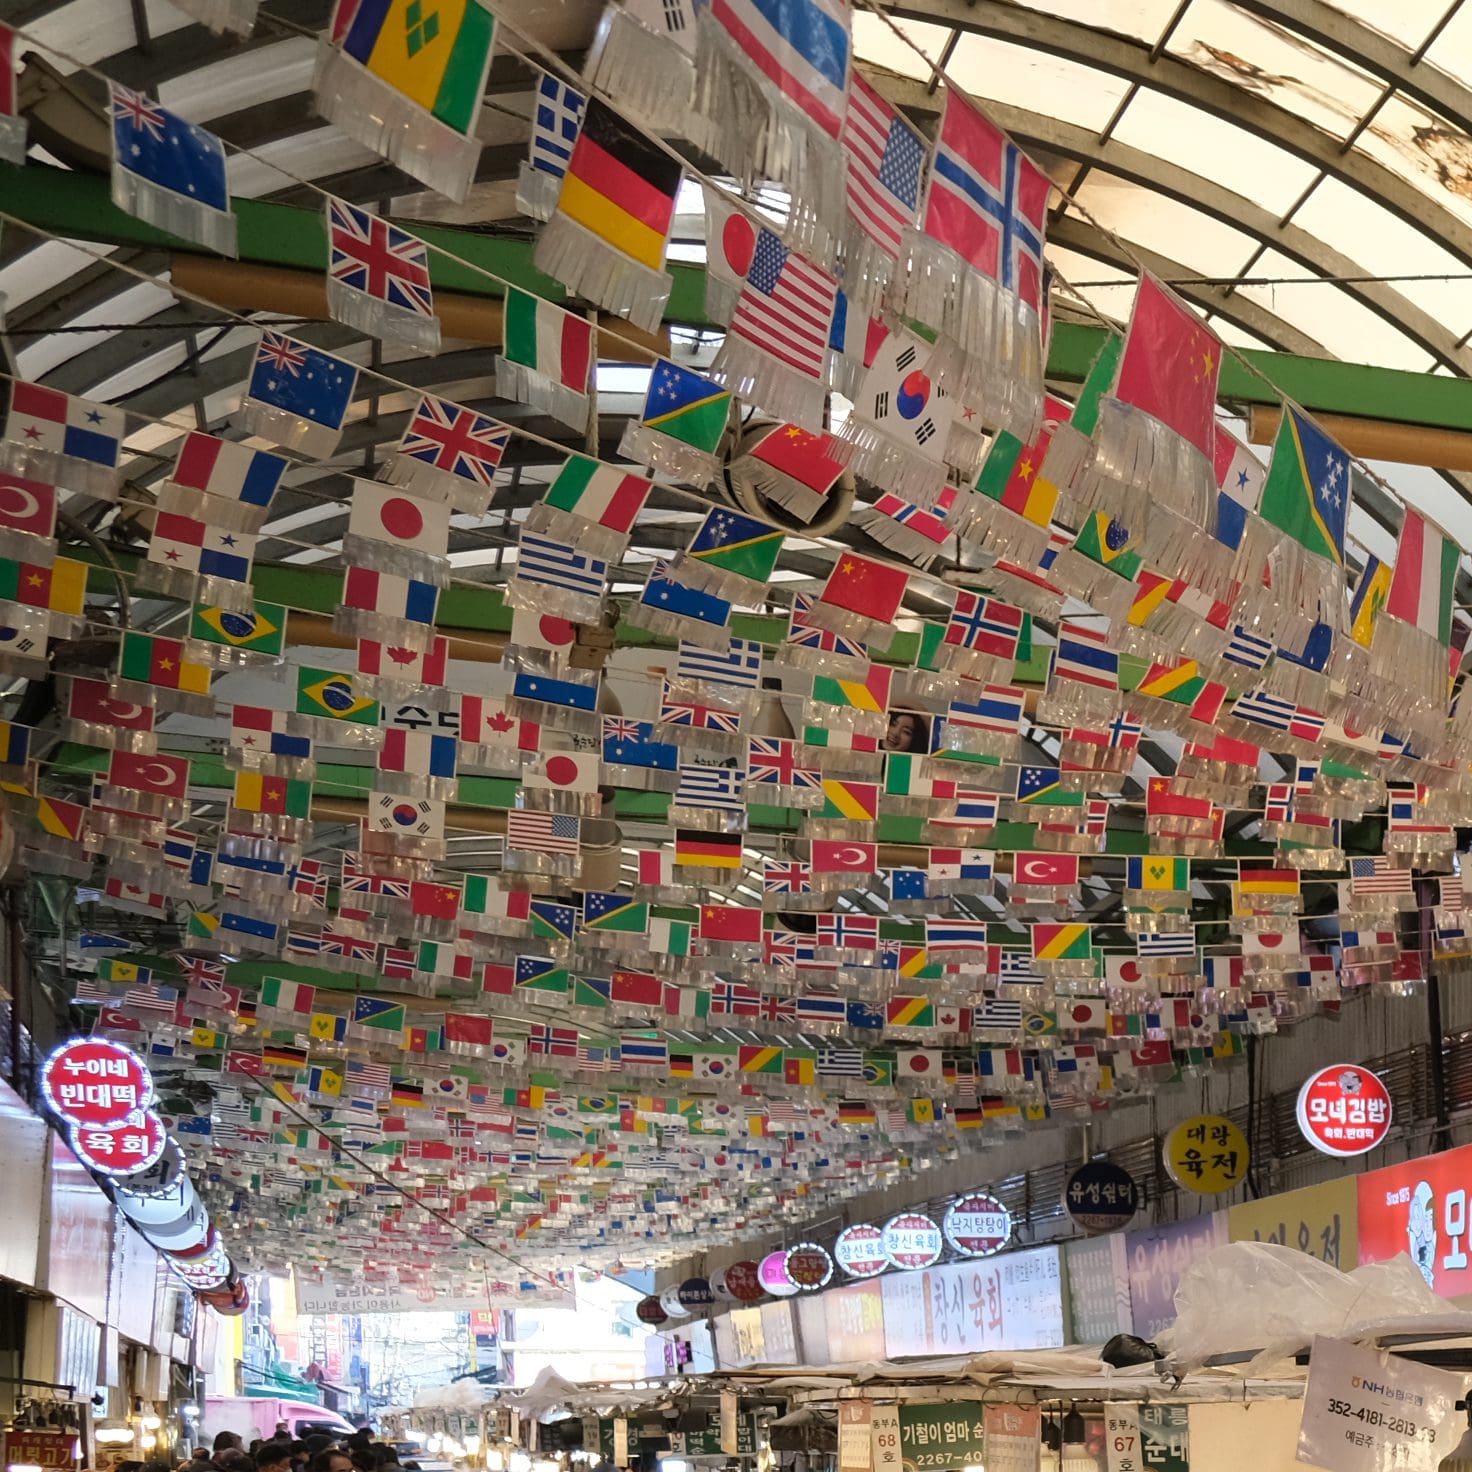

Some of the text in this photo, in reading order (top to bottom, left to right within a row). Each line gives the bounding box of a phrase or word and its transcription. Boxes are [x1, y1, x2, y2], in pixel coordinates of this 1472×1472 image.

[63, 1058, 128, 1077] 누이네
[60, 1083, 136, 1109] 빈대떡
[1310, 1097, 1388, 1124] 모녀김밥
[1187, 1124, 1231, 1146] 대광
[1179, 1148, 1238, 1179] 육전
[1069, 1183, 1132, 1204] 유성쉼터
[952, 1216, 1007, 1234] 낙지탕탕이
[889, 1234, 938, 1250] 창신육회
[934, 1269, 1004, 1345] 창신육회
[1362, 1380, 1385, 1395] NH
[872, 1418, 898, 1430] 동부A
[1328, 1398, 1436, 1443] 352-4181-28133
[878, 1434, 896, 1447] 68
[903, 1422, 942, 1445] 기철이
[944, 1420, 970, 1443] 엄마
[1114, 1436, 1135, 1452] 67
[1145, 1431, 1189, 1462] 순대
[882, 1451, 896, 1463] 호
[1119, 1458, 1135, 1472] 호
